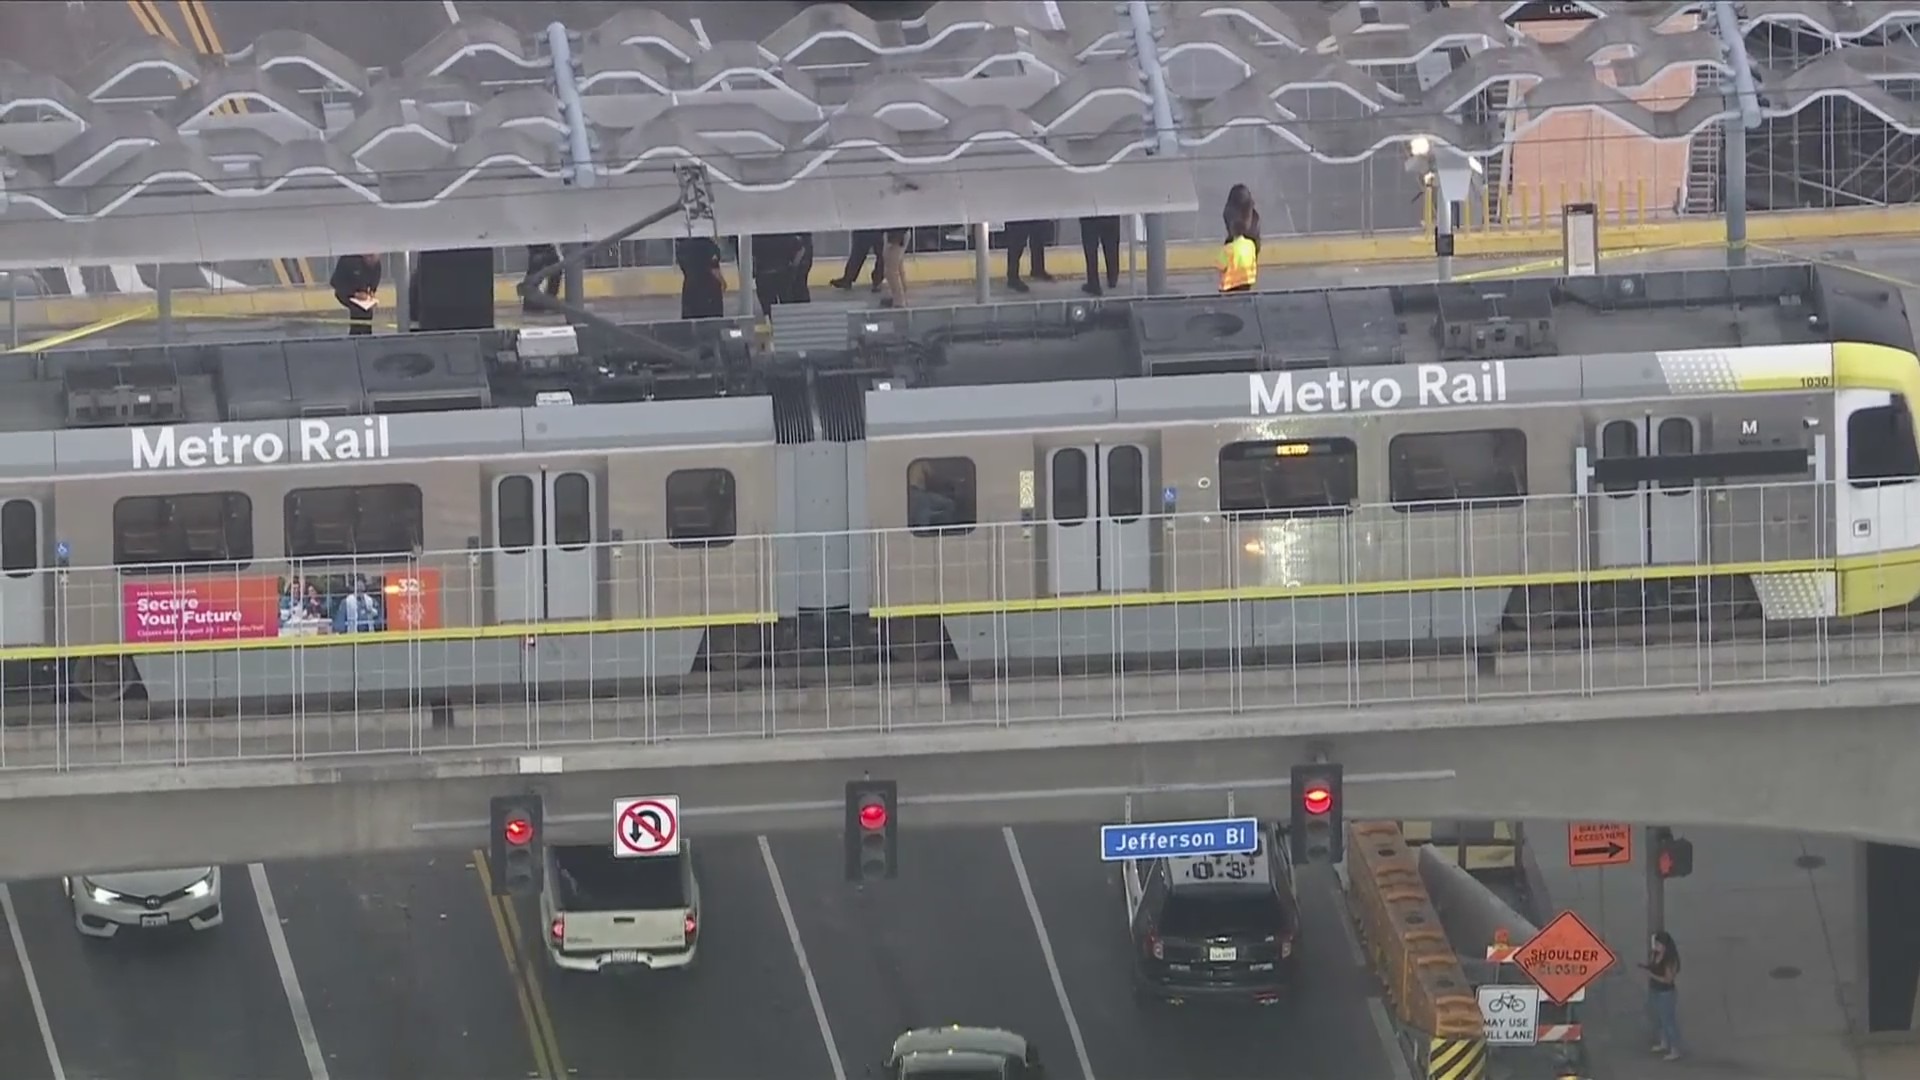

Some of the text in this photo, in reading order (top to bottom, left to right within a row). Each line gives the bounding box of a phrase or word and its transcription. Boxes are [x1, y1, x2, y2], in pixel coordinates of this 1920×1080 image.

[1549, 5, 1561, 14] La
[1250, 361, 1506, 415] Metro Rail
[1800, 376, 1829, 388] 1030
[131, 415, 390, 469] Metro Rail
[137, 598, 199, 612] Secure
[137, 610, 242, 626] Your Future
[1116, 831, 1215, 851] Jefferson
[1530, 949, 1599, 961] SHOULDER
[1483, 1018, 1528, 1028] MAY USE
[1483, 1030, 1533, 1040] ULL LANE
